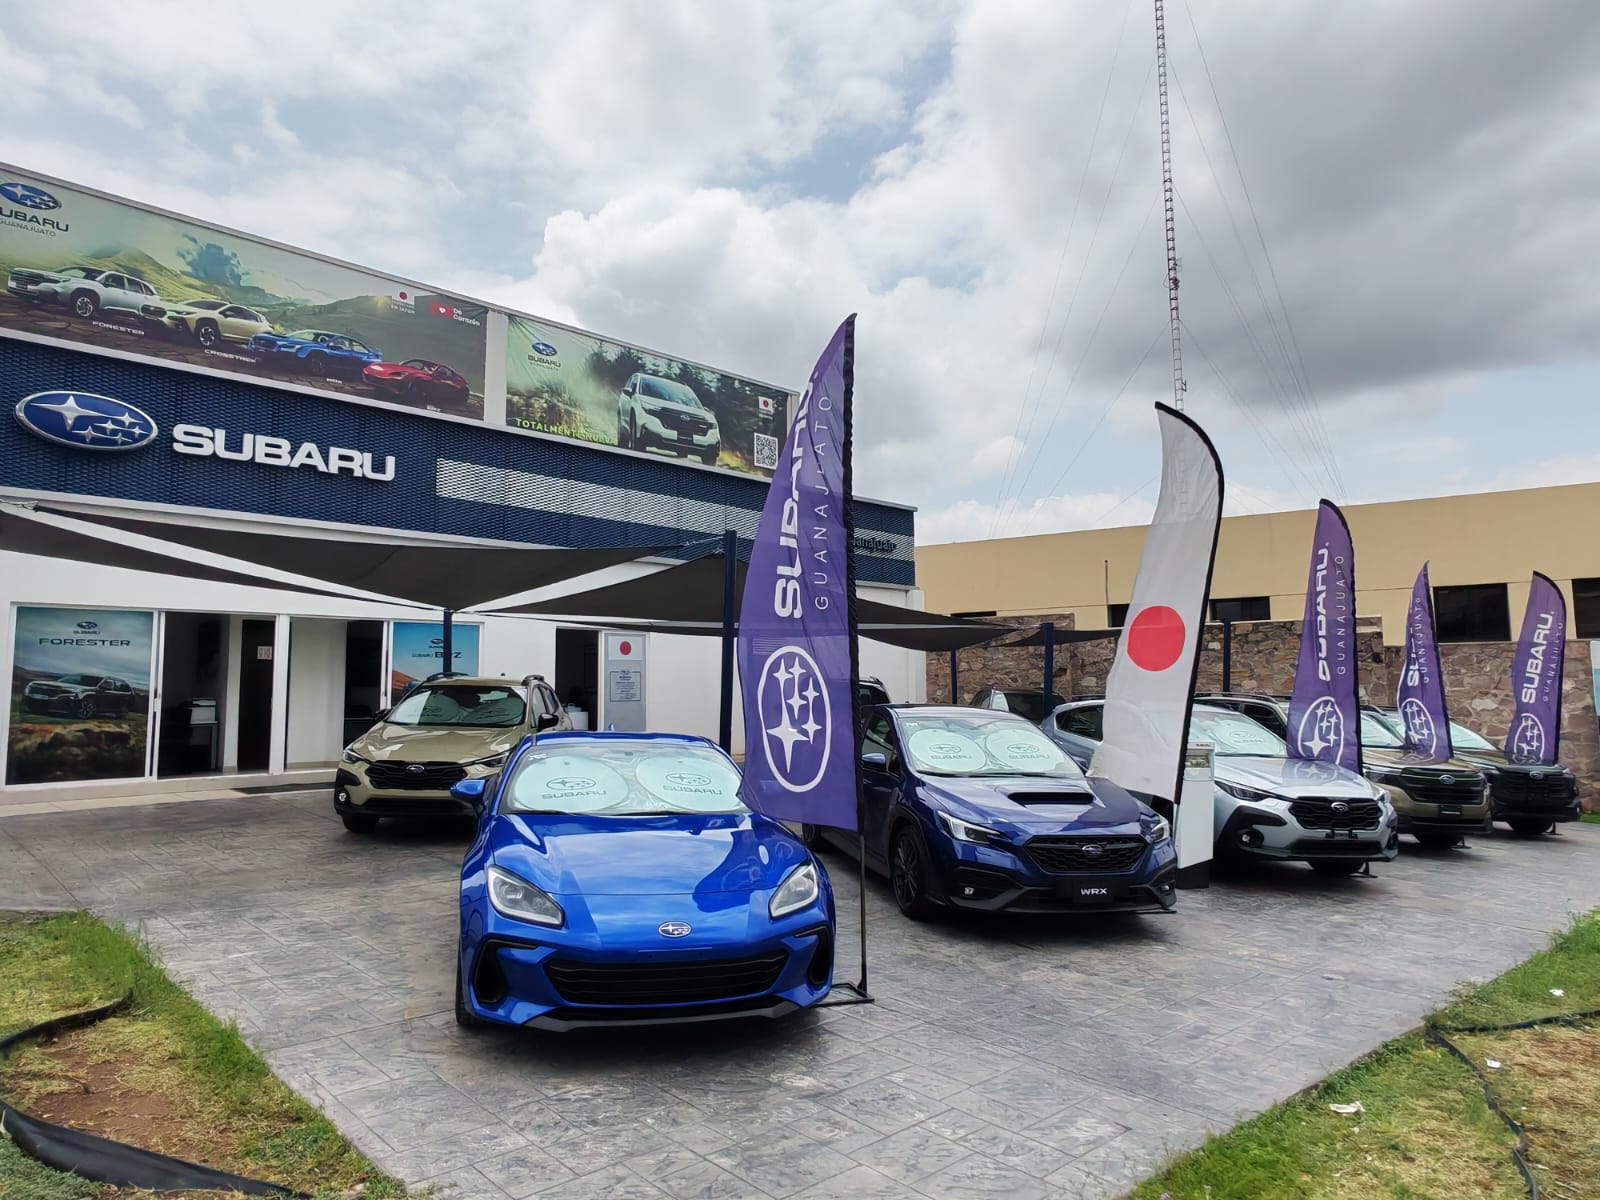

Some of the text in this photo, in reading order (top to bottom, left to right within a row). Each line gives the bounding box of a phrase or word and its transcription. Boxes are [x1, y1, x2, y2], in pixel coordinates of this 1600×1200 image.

[0, 206, 69, 232] UBARU
[92, 320, 145, 336] FORESTER
[527, 354, 561, 368] SUBARU
[172, 423, 396, 481] SUBARU
[814, 395, 833, 610] GUANAJATO
[38, 637, 131, 647] FORESTER
[434, 651, 462, 659] BZ
[1521, 613, 1553, 704] SUBARU
[541, 789, 607, 800] SUBARU
[662, 785, 723, 796] SUBARU
[1080, 887, 1108, 896] WRX
